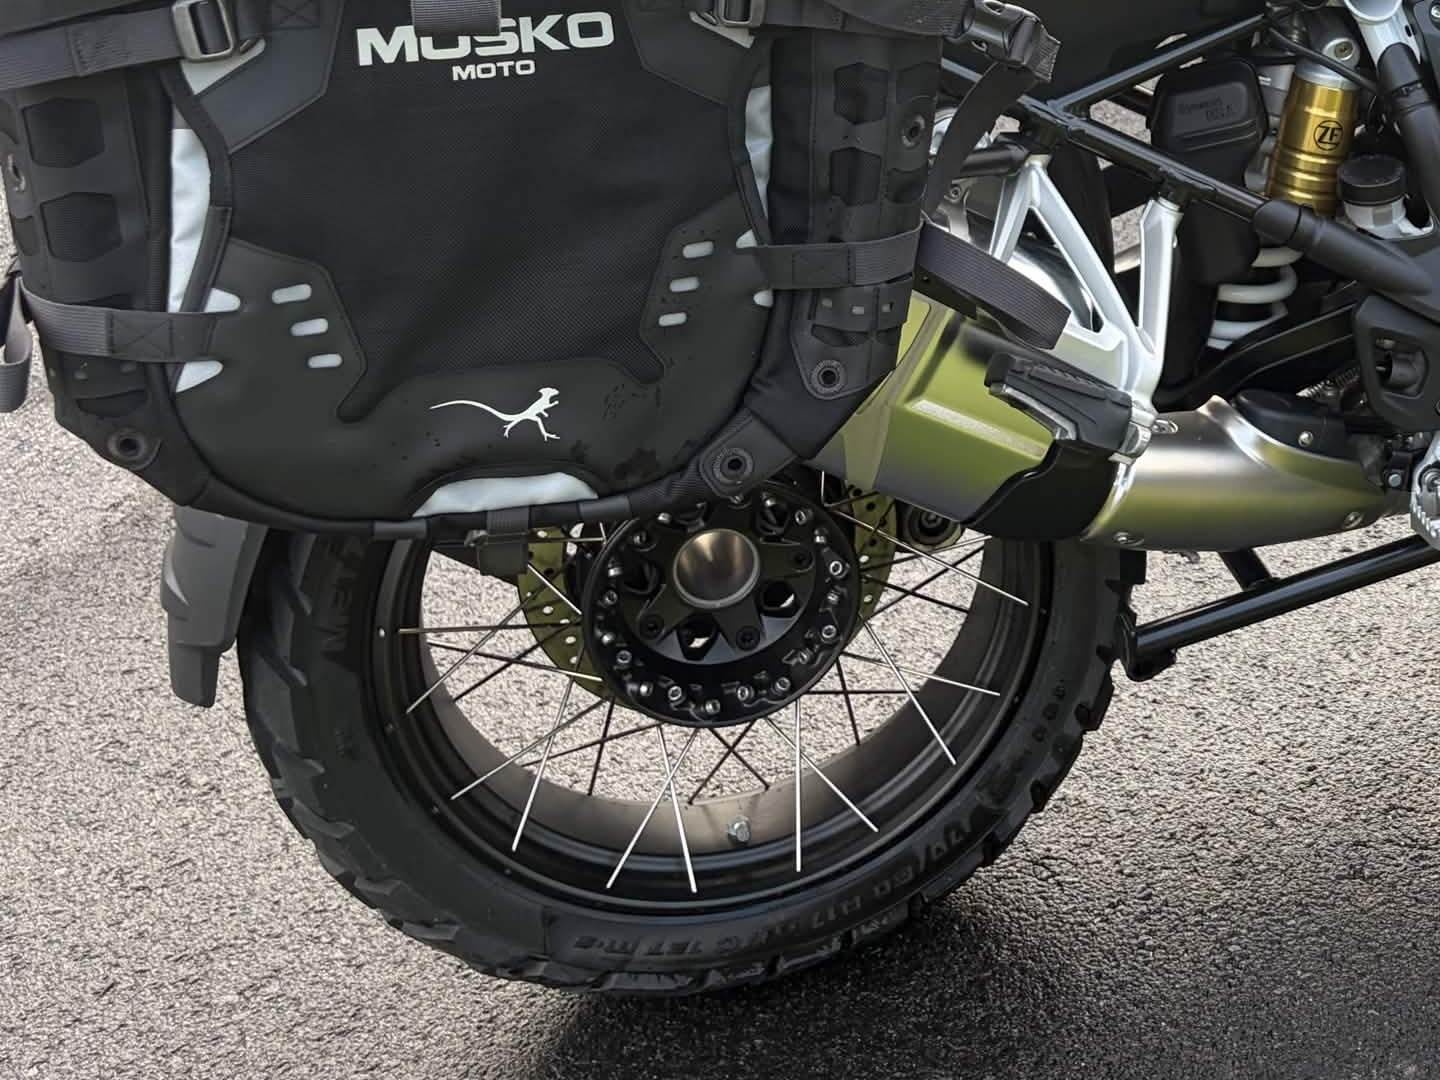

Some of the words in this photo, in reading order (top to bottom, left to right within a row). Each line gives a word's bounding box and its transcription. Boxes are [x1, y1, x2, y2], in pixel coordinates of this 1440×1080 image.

[356, 11, 615, 66] MUSKO
[452, 59, 536, 81] MOTO
[1316, 124, 1343, 147] ZF
